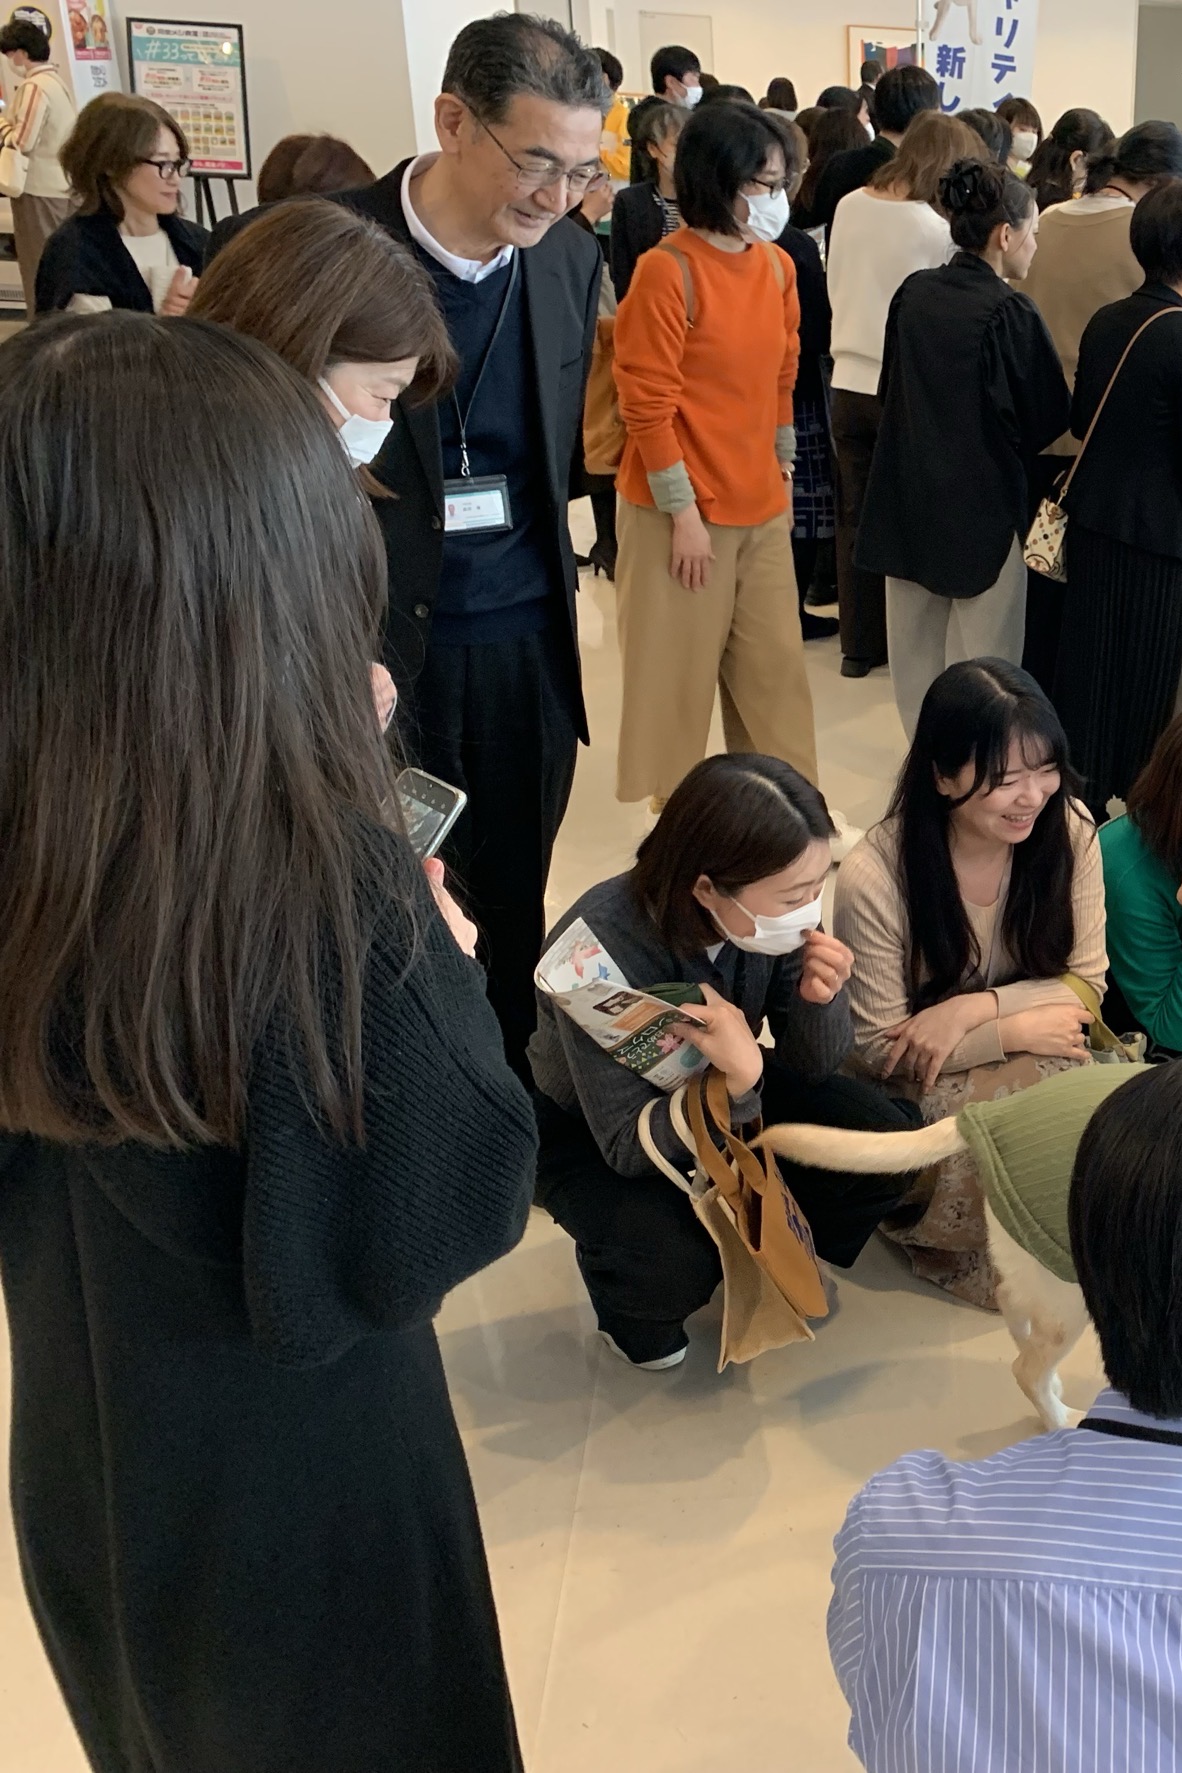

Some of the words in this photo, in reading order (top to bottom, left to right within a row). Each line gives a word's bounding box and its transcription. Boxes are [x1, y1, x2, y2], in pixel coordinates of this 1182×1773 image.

[936, 44, 966, 112] 新し
[627, 1030, 664, 1059] おめでとう
